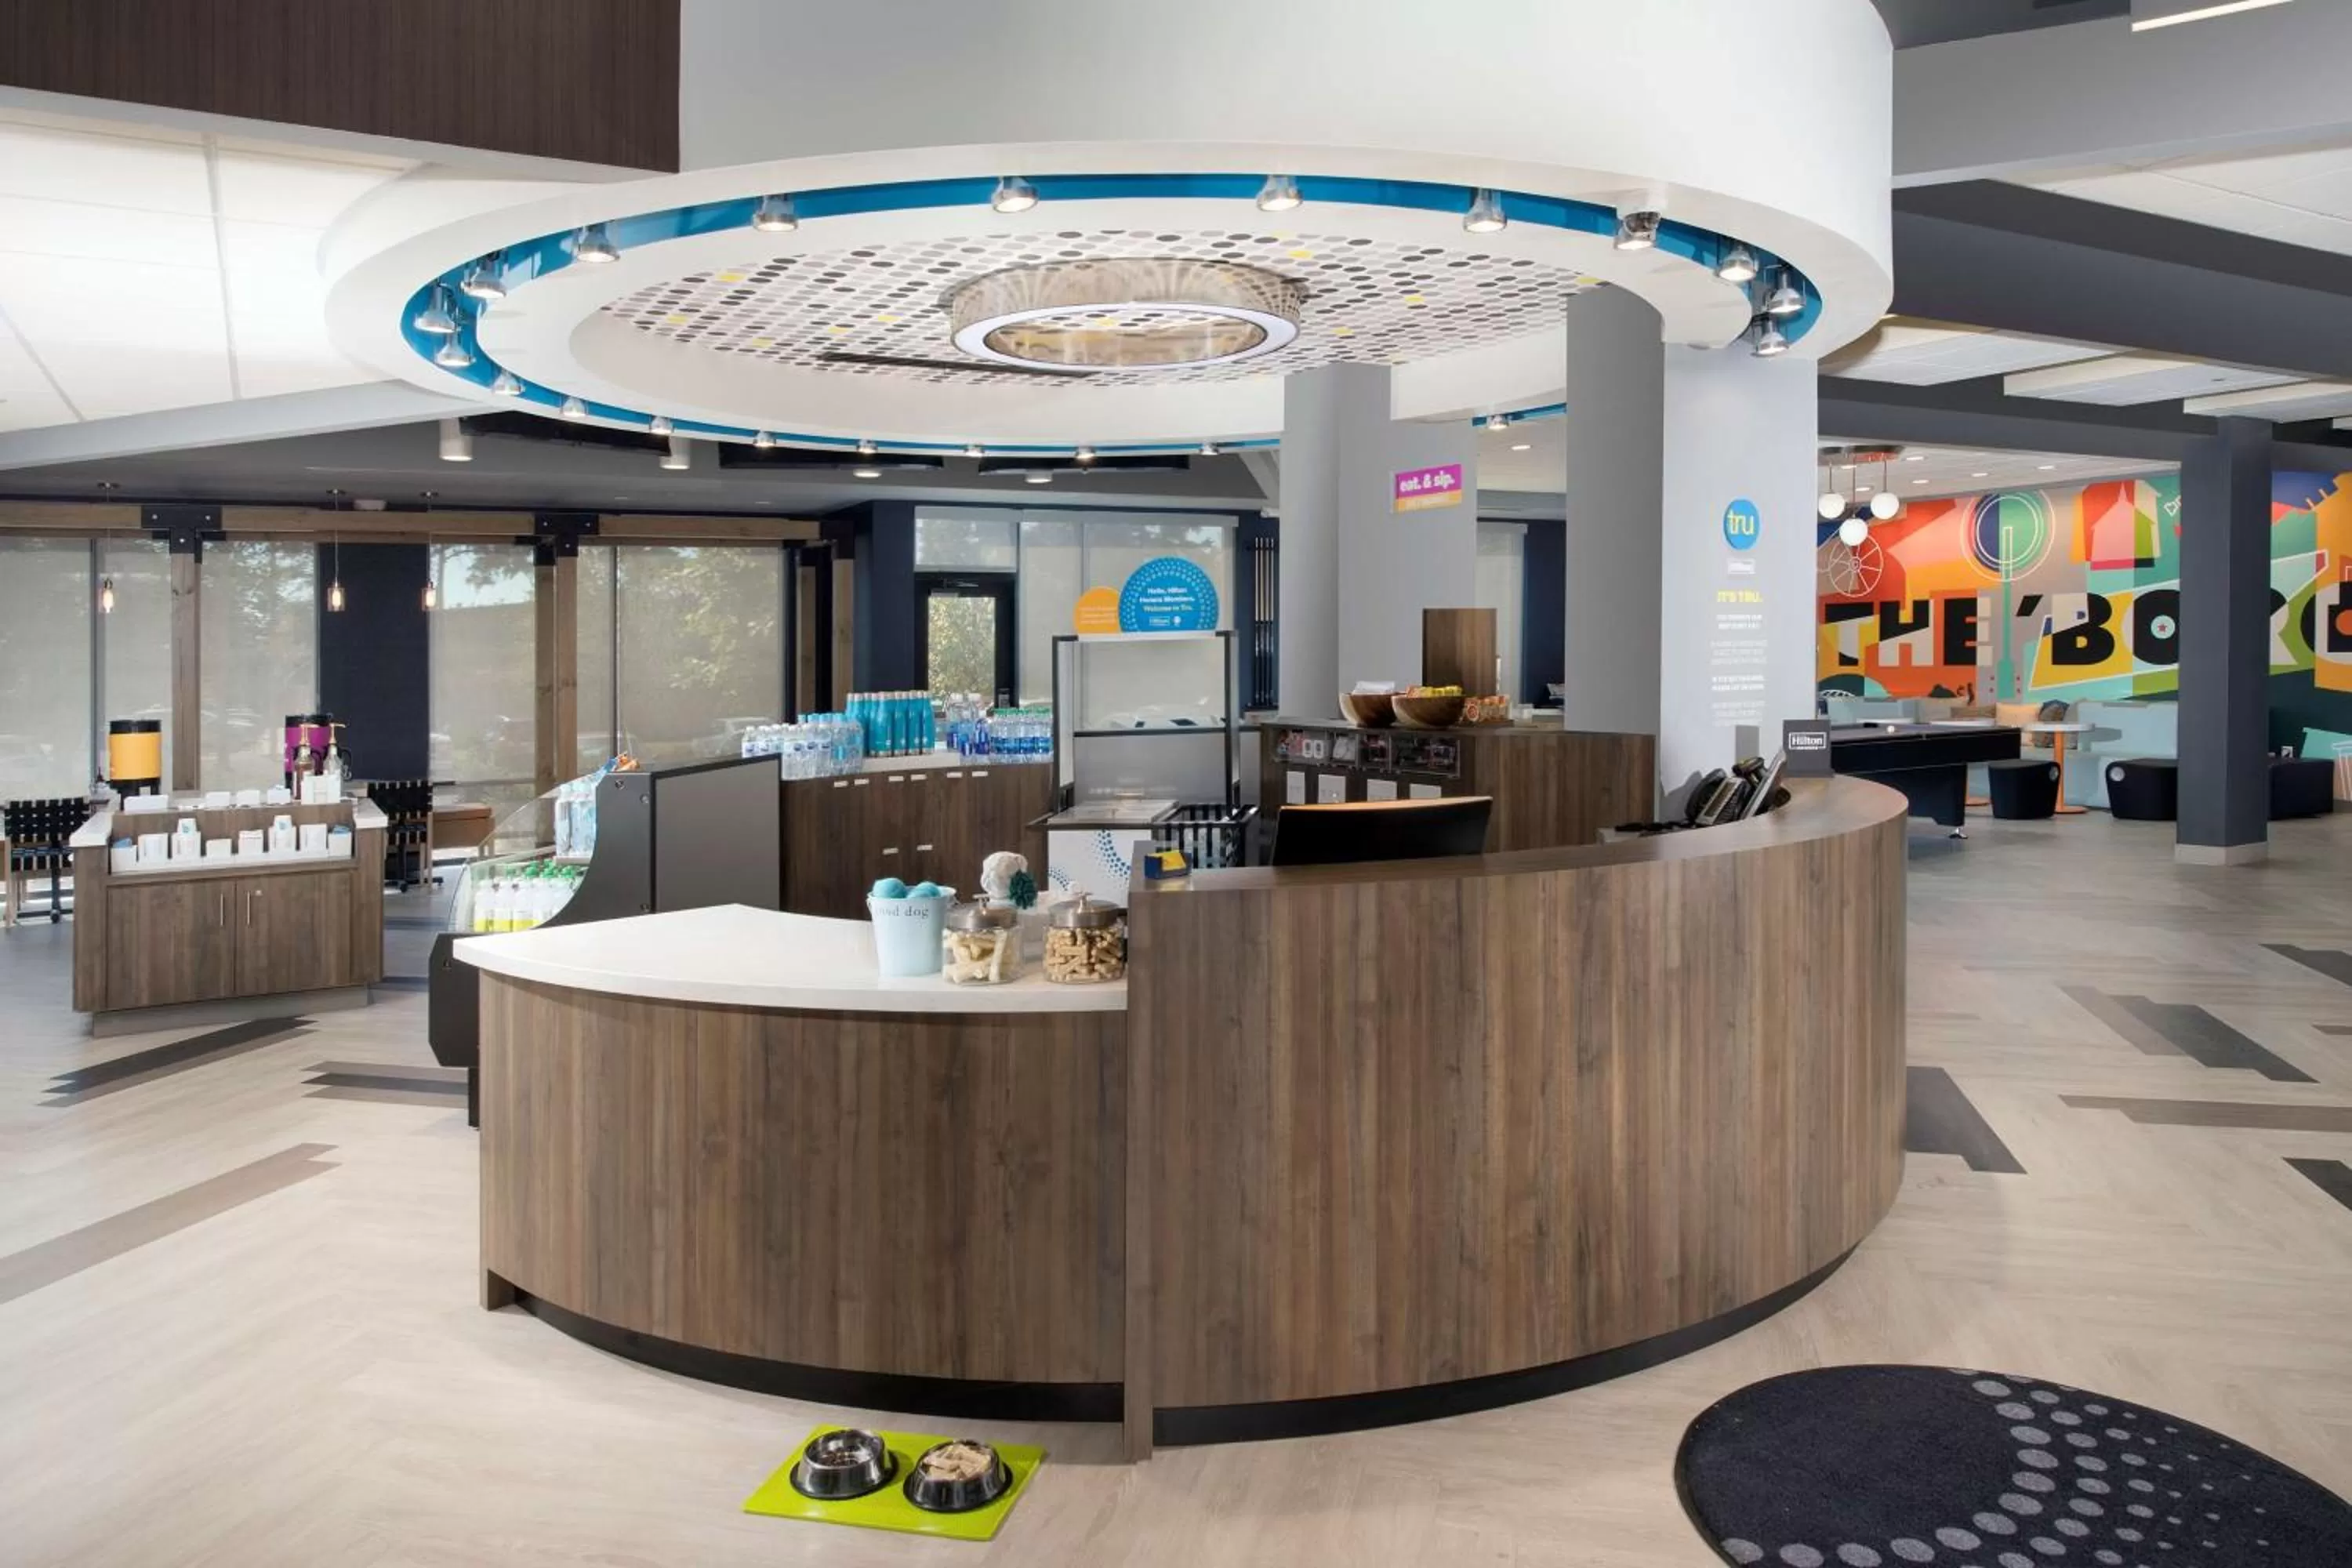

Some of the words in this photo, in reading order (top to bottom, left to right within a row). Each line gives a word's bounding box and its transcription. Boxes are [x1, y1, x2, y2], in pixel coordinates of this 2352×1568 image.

[1399, 476, 1422, 492] eat.
[1423, 473, 1432, 489] &
[1433, 470, 1456, 490] sip.
[1726, 508, 1755, 535] tru
[1824, 597, 1994, 667] THE
[1791, 735, 1823, 746] Hilton
[903, 905, 929, 920] dog
